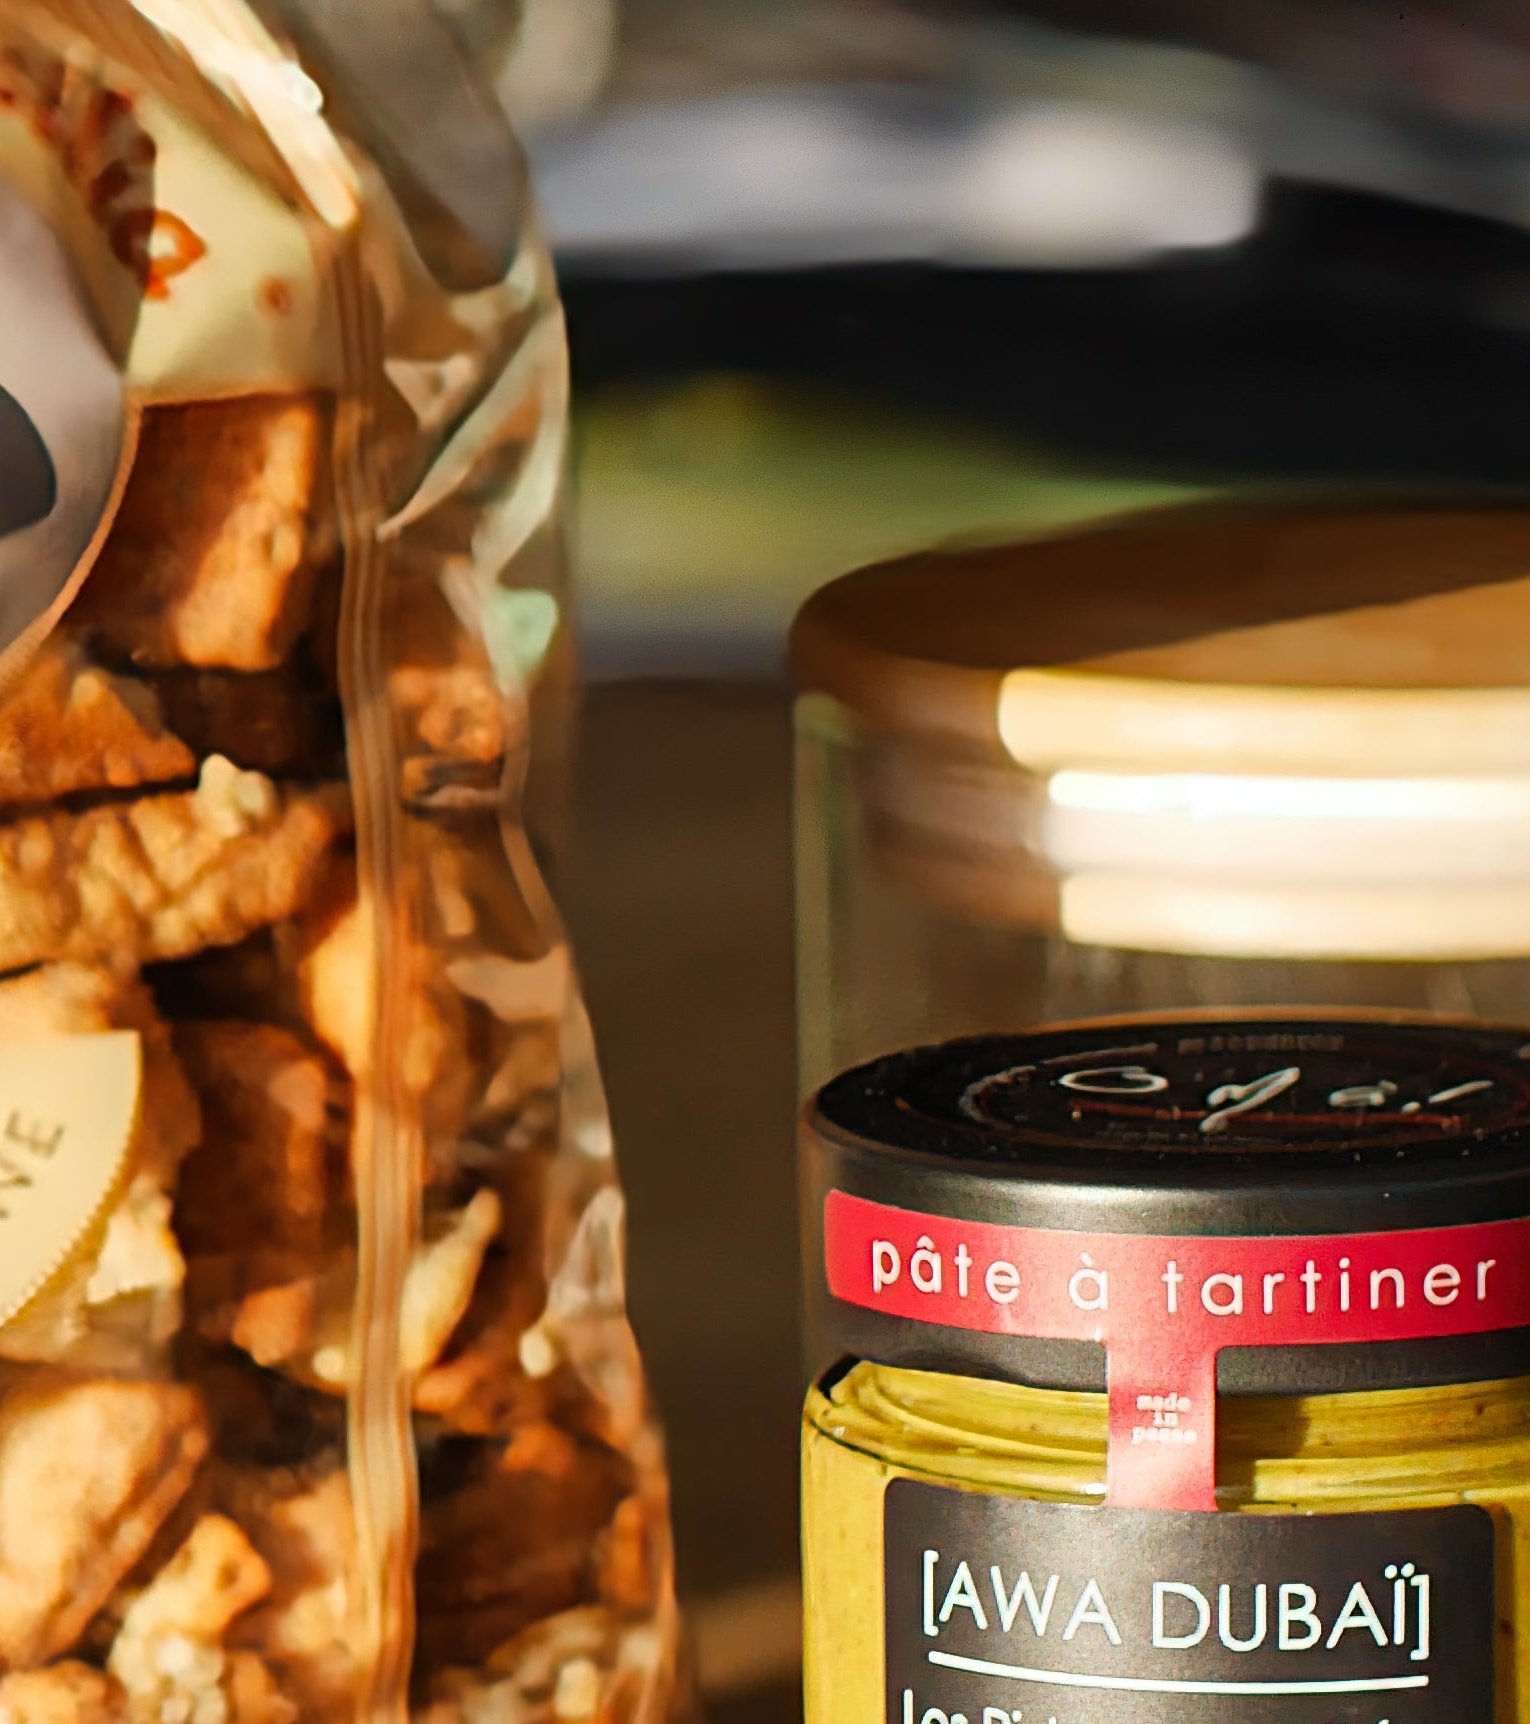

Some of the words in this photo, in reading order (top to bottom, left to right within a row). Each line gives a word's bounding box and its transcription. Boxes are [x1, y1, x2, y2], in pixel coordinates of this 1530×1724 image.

[871, 1235, 1022, 1306] pâte
[1068, 1252, 1111, 1313] à
[1161, 1256, 1498, 1318] tartiner
[922, 1549, 1122, 1646] [AWA
[1151, 1562, 1430, 1661] DUBAÏ]
